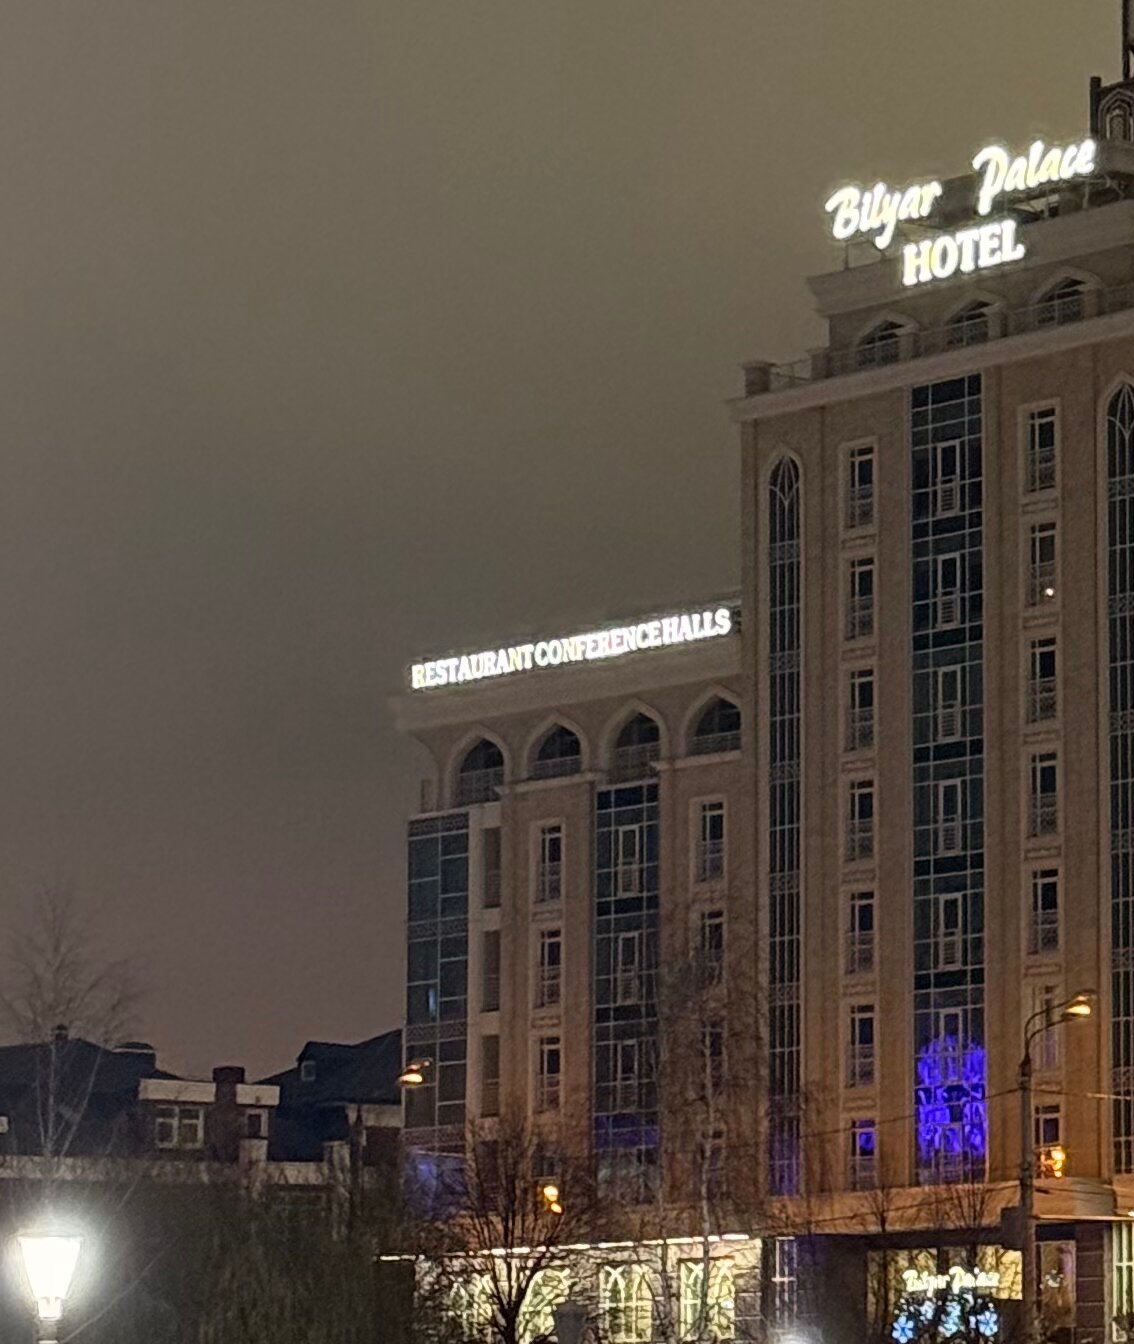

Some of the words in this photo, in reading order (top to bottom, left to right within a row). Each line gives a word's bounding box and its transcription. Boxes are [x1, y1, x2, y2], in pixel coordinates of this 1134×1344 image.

[824, 180, 943, 250] Bilyar
[971, 138, 1097, 216] Palace
[902, 218, 1026, 286] HOTEL
[411, 643, 535, 689] RESTAURANT
[534, 621, 662, 667] CONFERENCE
[662, 608, 732, 643] HALLS
